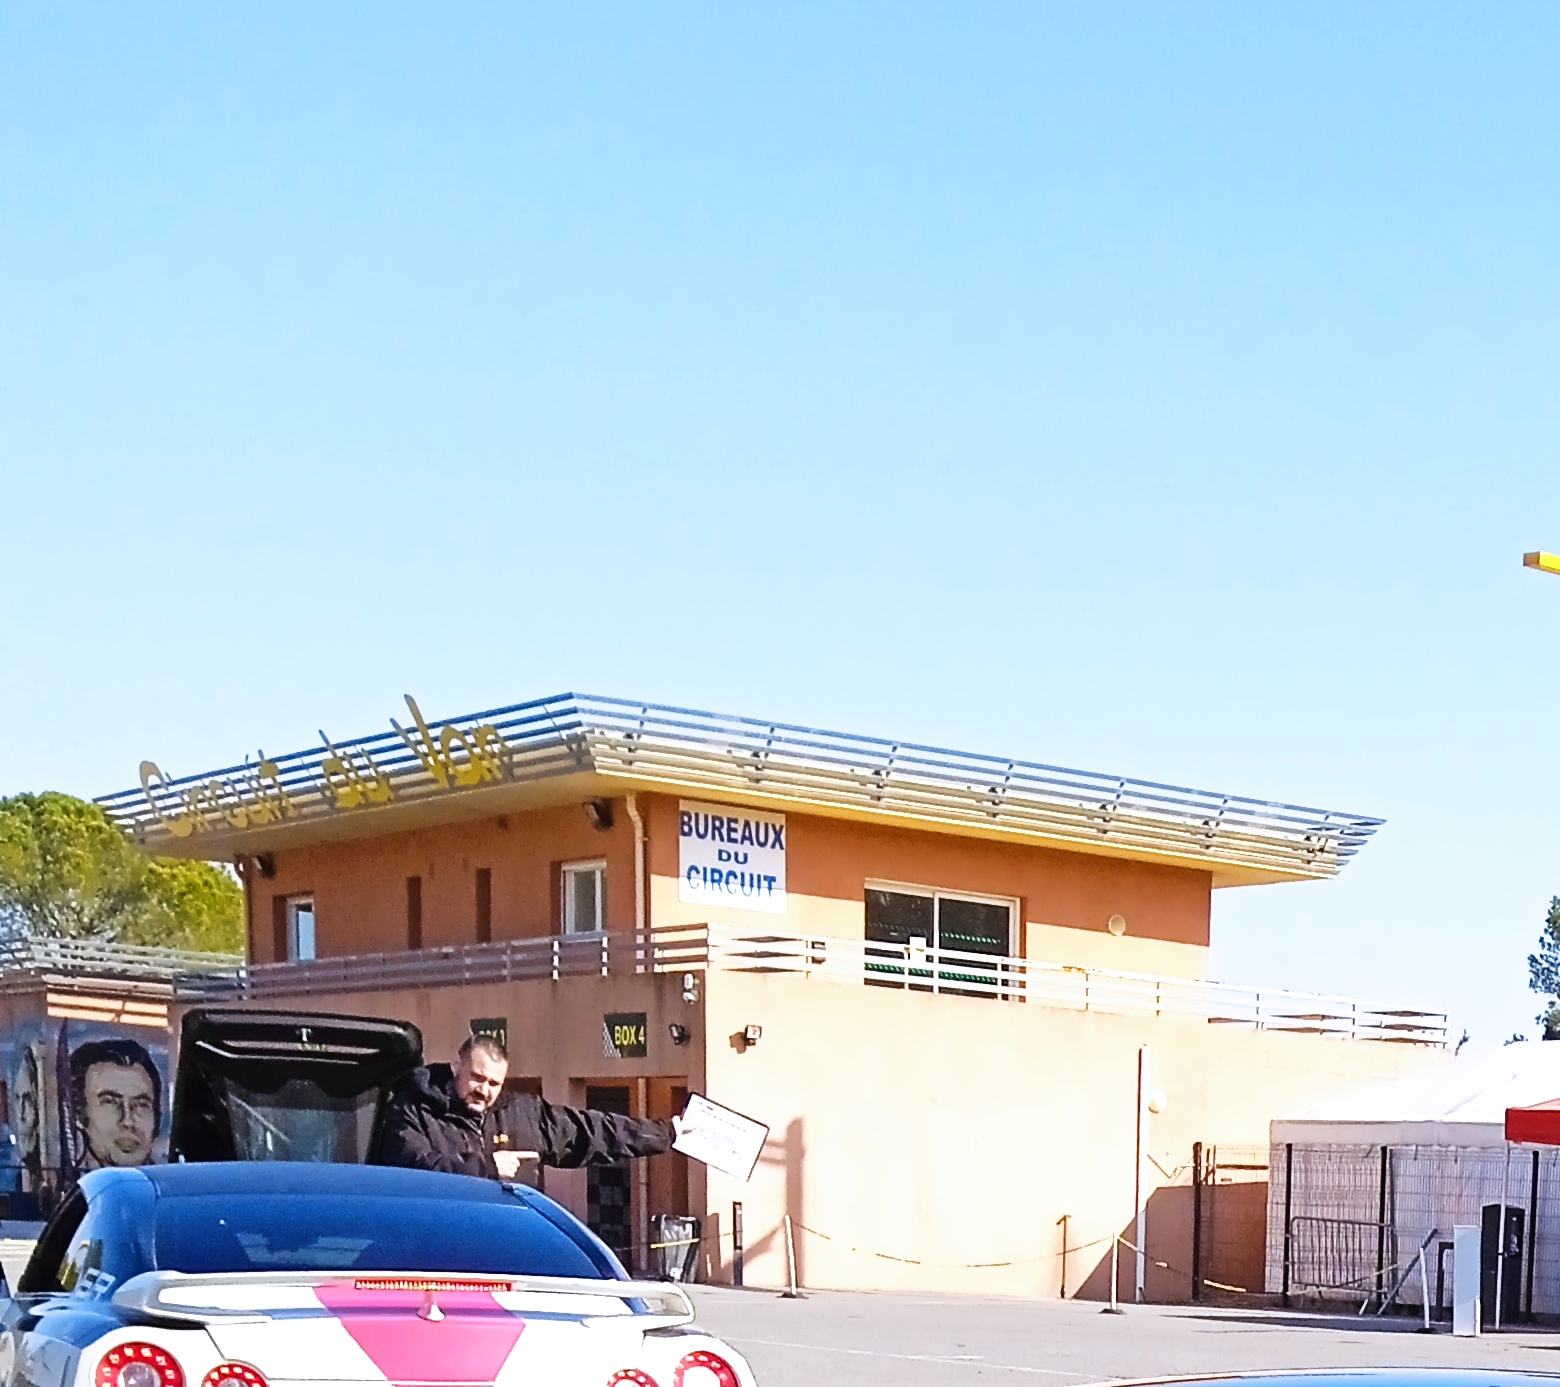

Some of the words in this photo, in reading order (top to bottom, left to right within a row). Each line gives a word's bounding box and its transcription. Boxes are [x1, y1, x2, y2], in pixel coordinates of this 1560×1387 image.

[680, 810, 784, 850] BUREAUX
[718, 849, 748, 865] DU
[687, 865, 777, 898] CIRCUIT
[614, 1025, 637, 1045] BOX
[638, 1025, 645, 1044] 4
